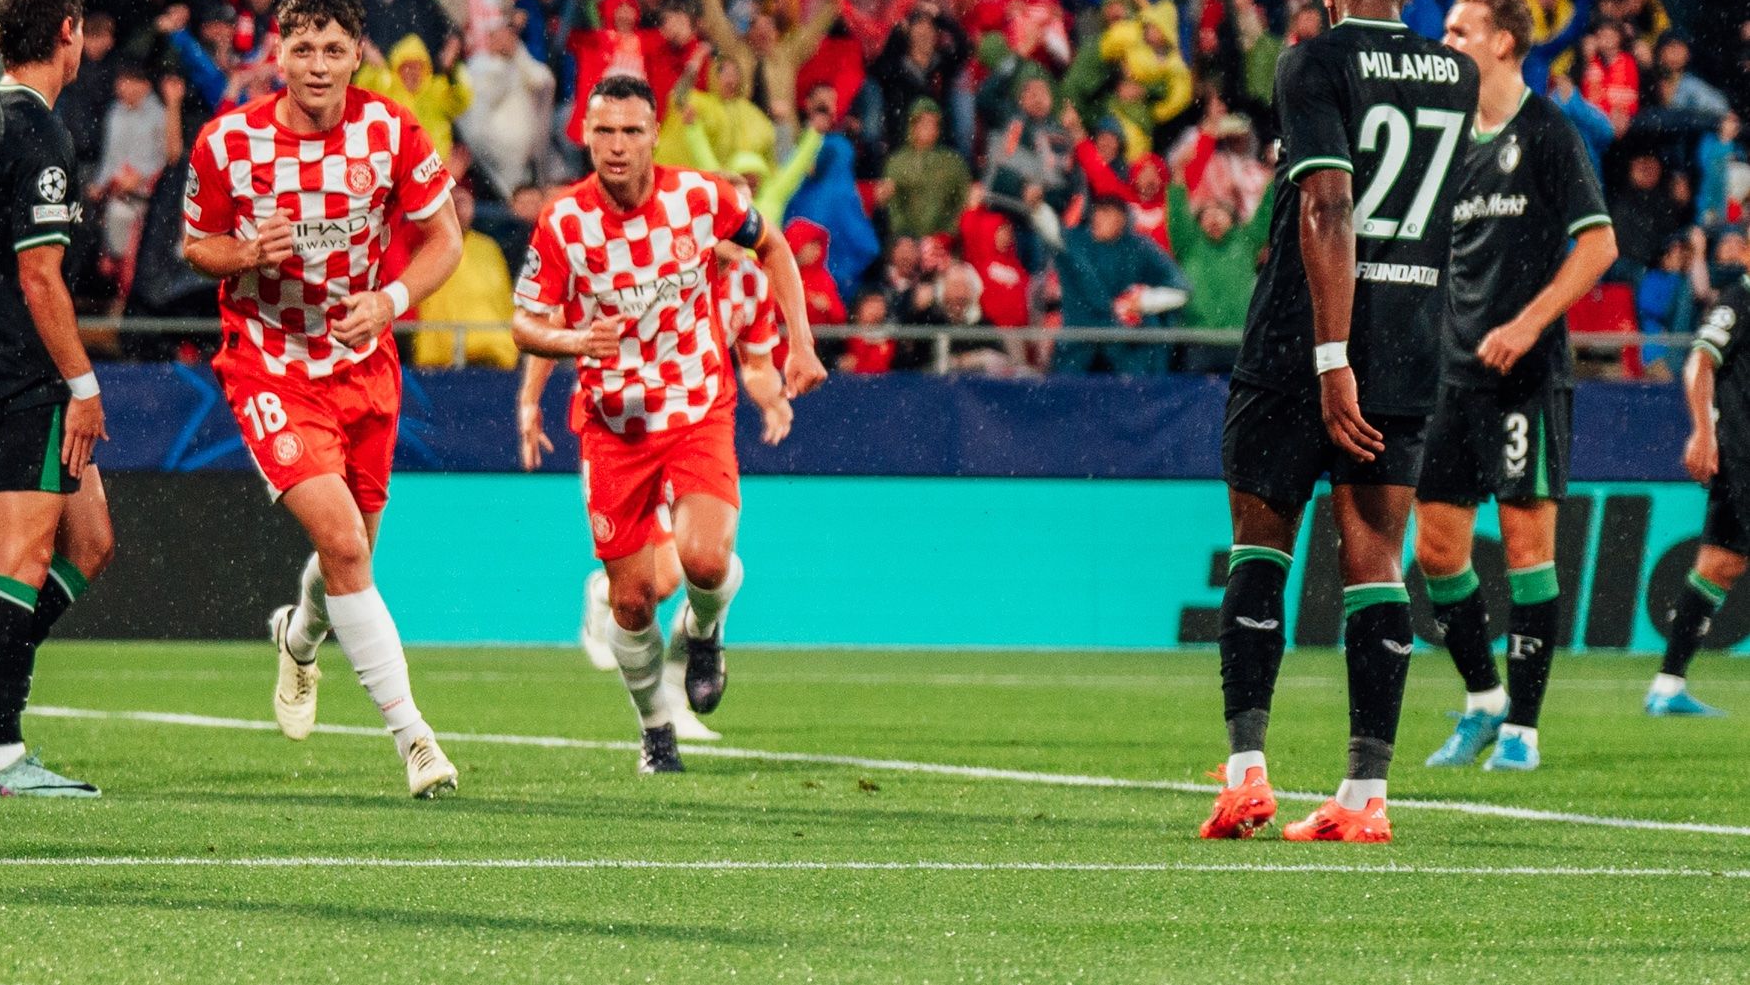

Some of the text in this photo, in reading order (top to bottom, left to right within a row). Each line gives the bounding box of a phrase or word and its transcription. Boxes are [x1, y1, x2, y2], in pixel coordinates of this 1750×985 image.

[1359, 52, 1460, 83] MILAMBO
[1352, 104, 1466, 239] 27
[295, 215, 368, 237] IHAD
[296, 239, 346, 252] RWAYS
[243, 391, 288, 441] 18
[1504, 412, 1528, 460] 3
